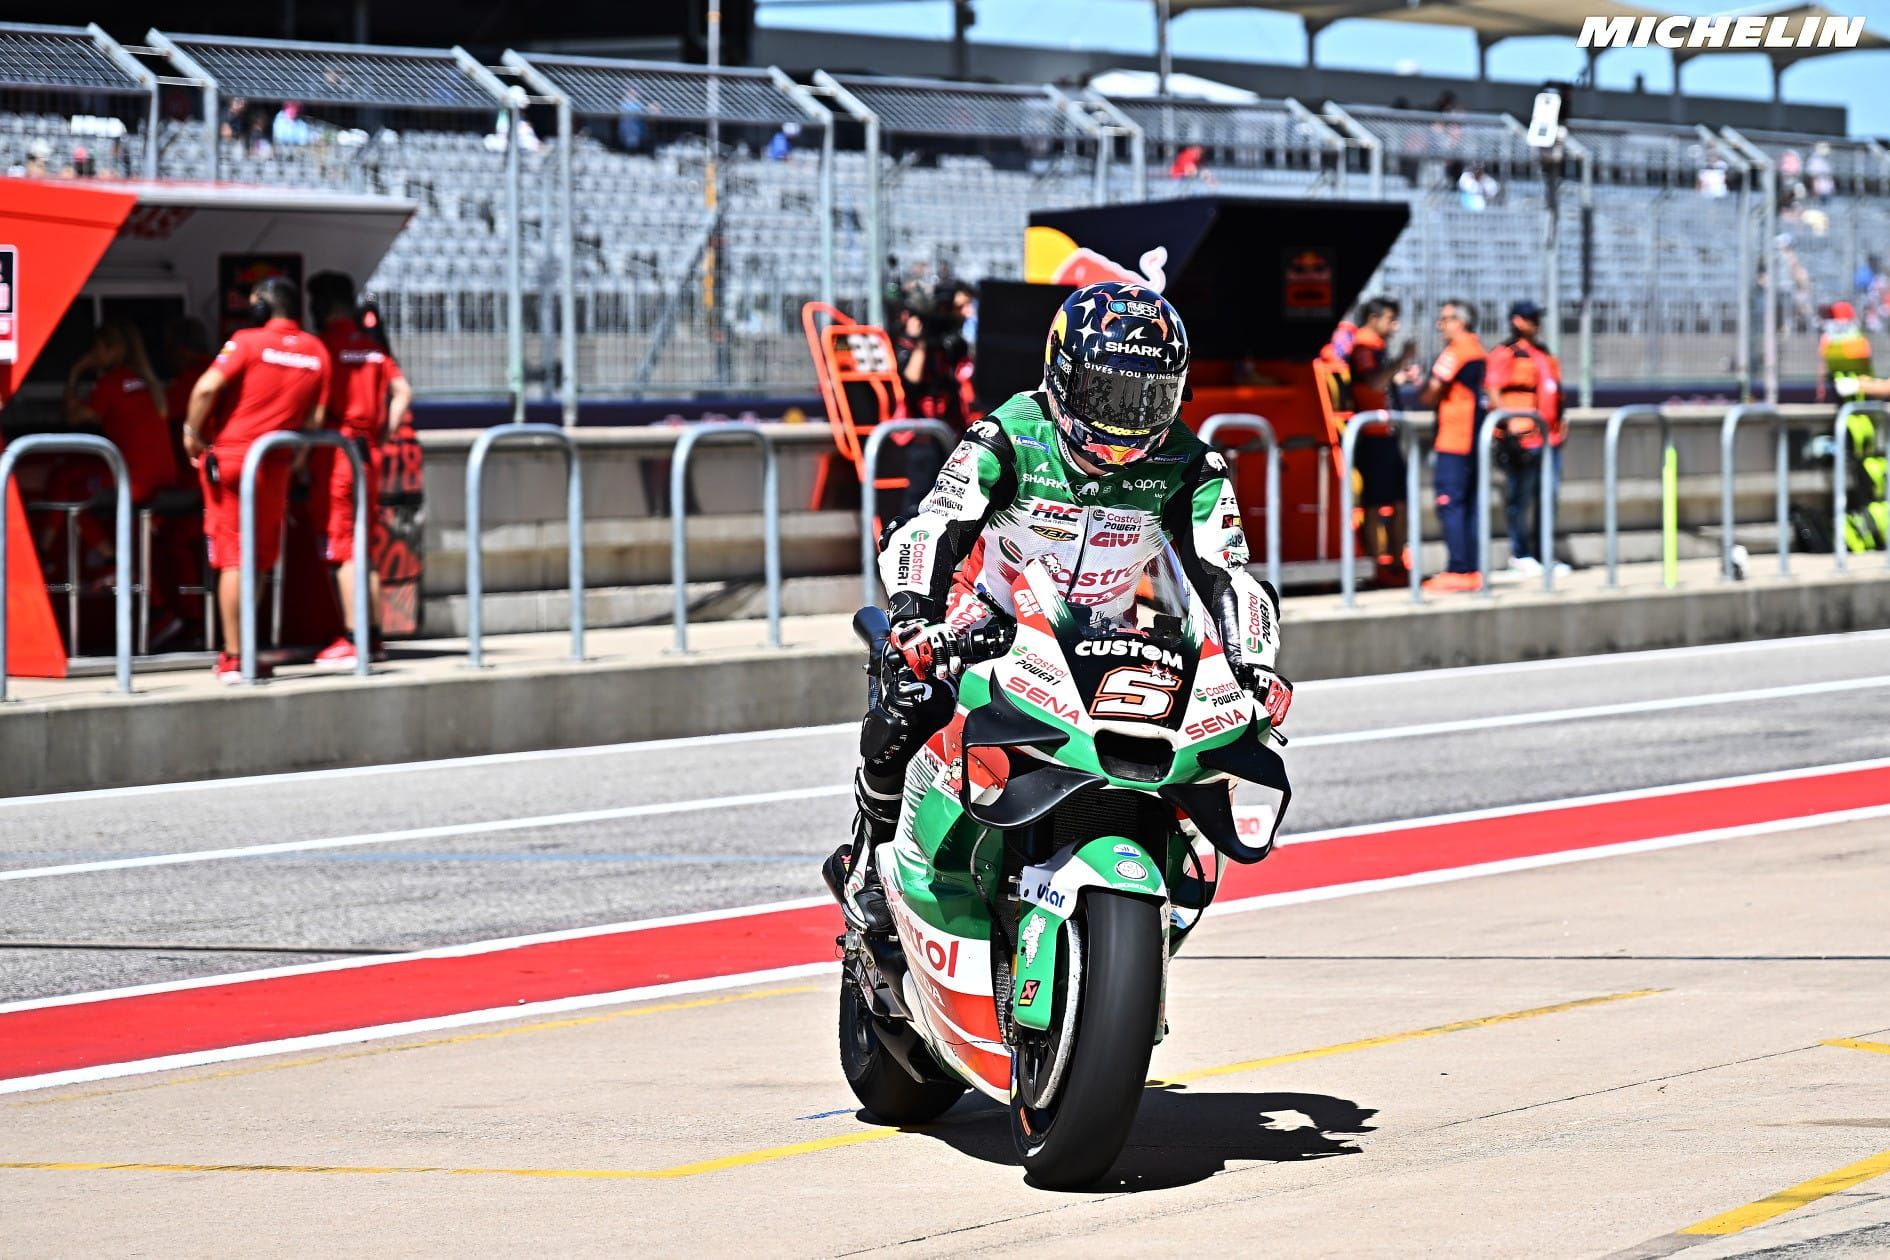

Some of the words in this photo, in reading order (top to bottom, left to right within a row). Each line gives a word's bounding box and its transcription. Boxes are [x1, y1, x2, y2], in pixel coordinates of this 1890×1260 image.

[1105, 341, 1163, 358] SHARK
[1084, 362, 1113, 374] GIVES
[1120, 369, 1141, 379] YOU
[1022, 473, 1069, 491] SHARK
[1031, 502, 1083, 522] HRC
[1107, 513, 1141, 524] Castrol
[1089, 531, 1140, 548] GIVI
[911, 543, 926, 585] Castrol
[1247, 591, 1261, 636] Castrol
[1026, 653, 1069, 679] Castrol
[1074, 639, 1183, 671] CUSTOM
[1089, 665, 1182, 720] 5
[1206, 680, 1239, 697] Castrol
[1006, 676, 1080, 725] SENA
[1185, 709, 1247, 741] SENA
